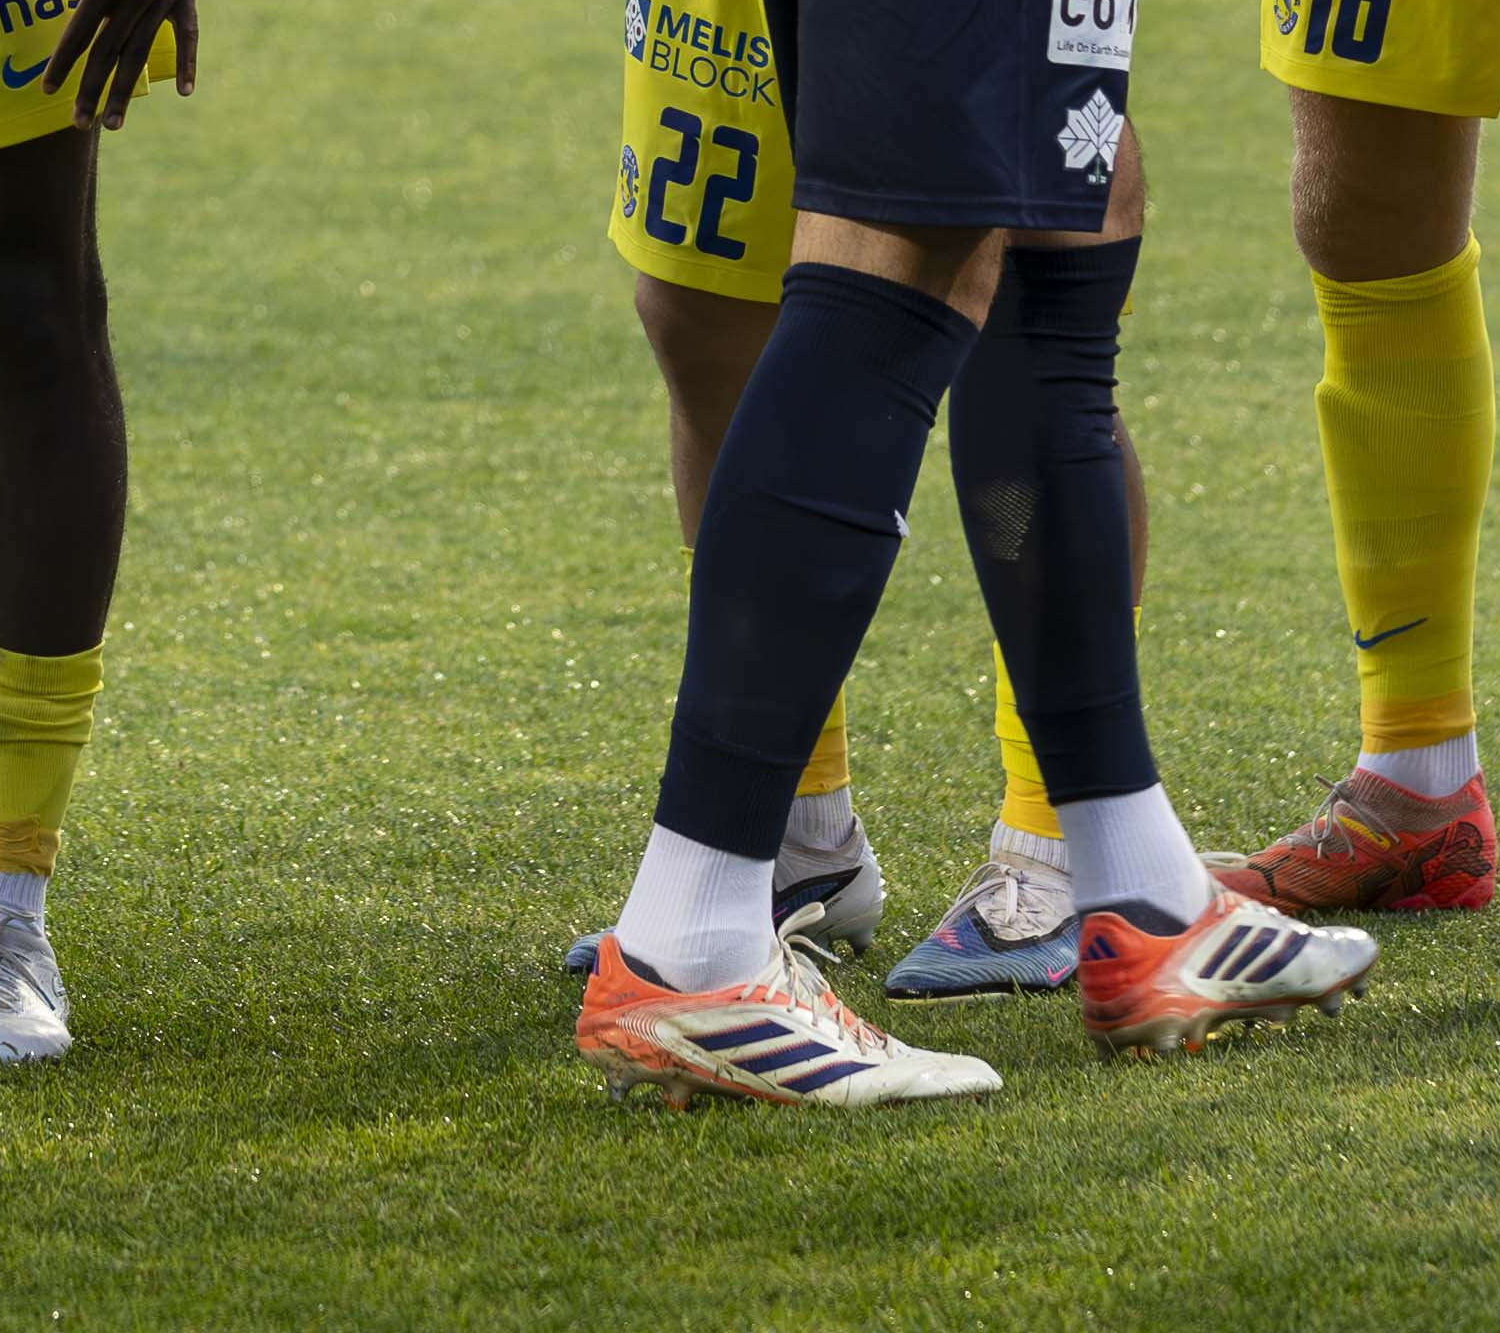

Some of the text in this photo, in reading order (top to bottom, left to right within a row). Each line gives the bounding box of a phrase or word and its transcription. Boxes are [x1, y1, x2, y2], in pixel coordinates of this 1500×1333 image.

[656, 5, 770, 68] MELIS
[650, 39, 777, 107] BLOCK
[645, 106, 759, 261] 22
